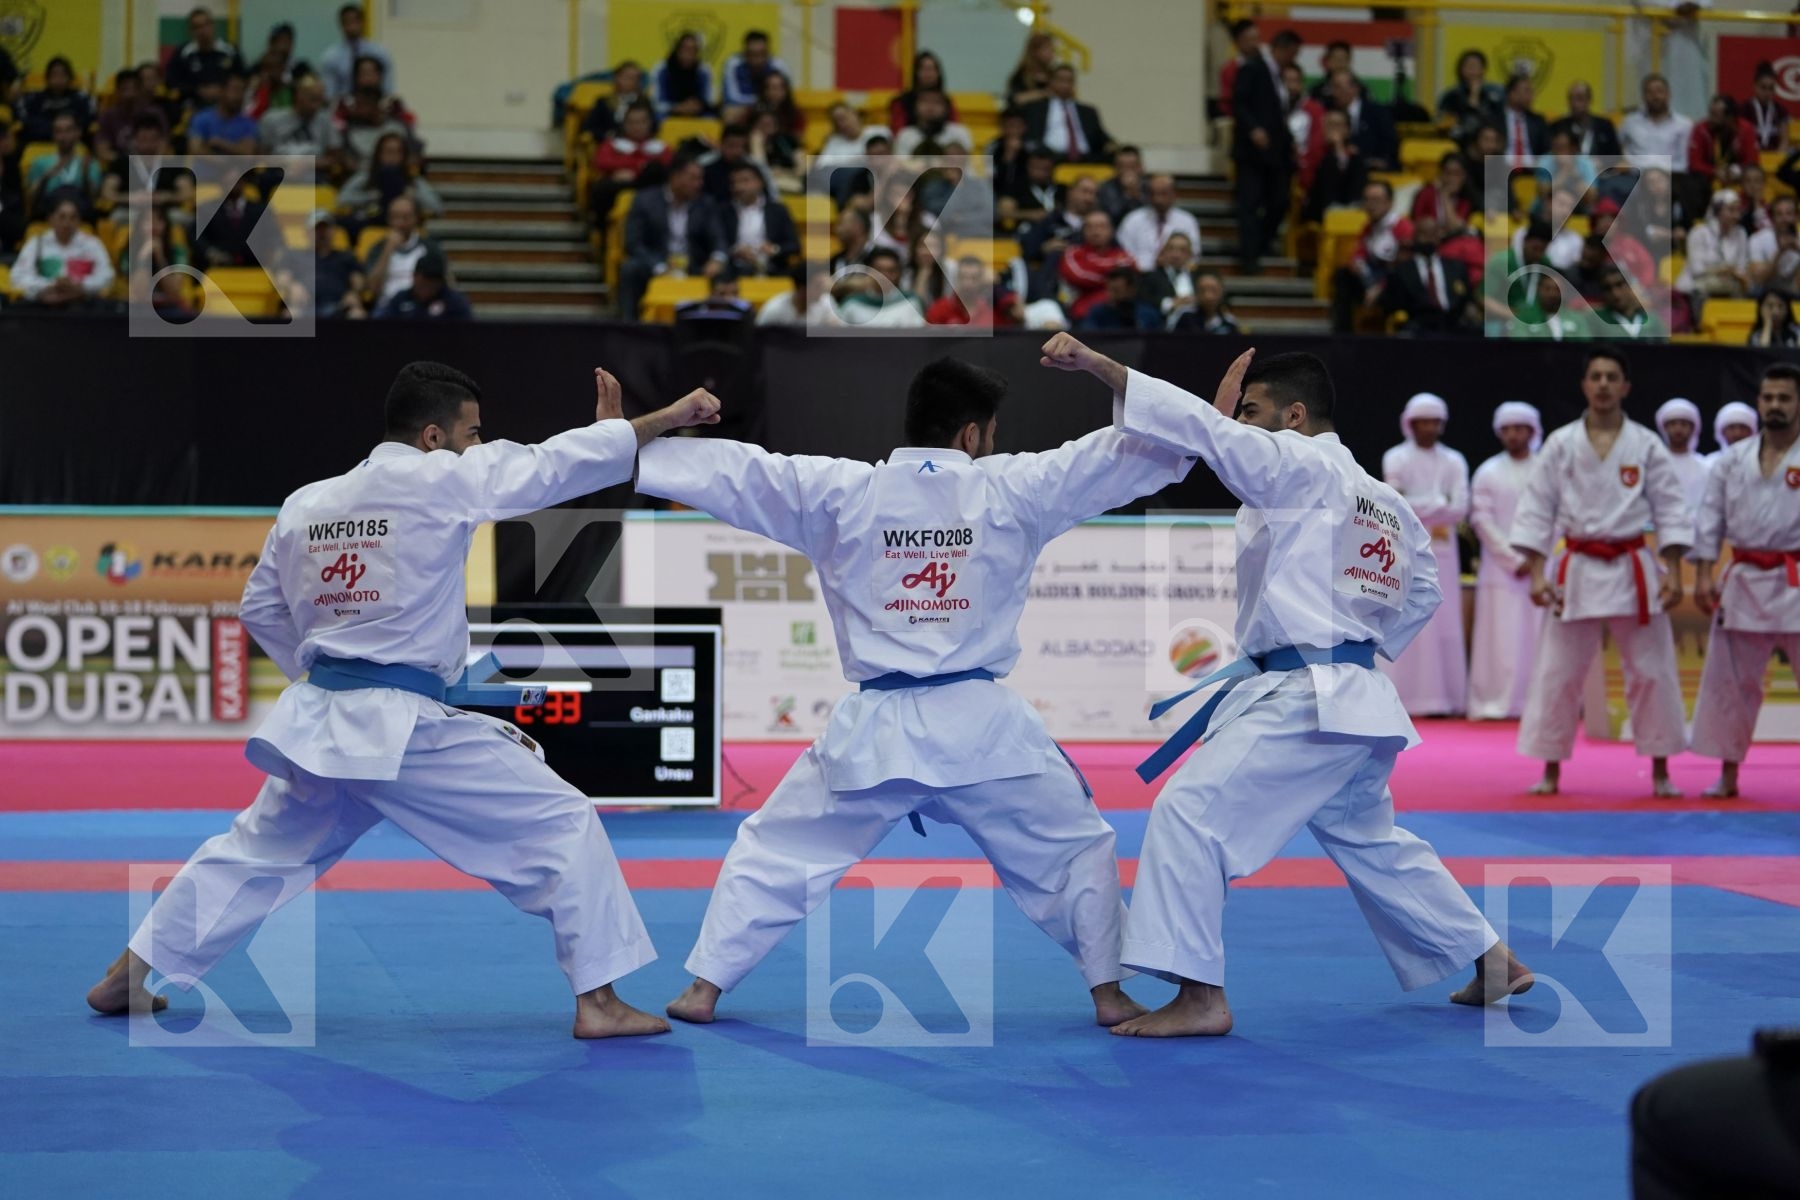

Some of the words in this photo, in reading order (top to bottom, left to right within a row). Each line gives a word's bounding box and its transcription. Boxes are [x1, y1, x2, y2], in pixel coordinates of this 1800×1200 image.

[309, 519, 389, 541] WKF0185
[883, 528, 973, 547] WKF0208
[308, 545, 321, 553] Eat
[342, 541, 359, 550] Live
[885, 550, 901, 559] Eat
[930, 550, 950, 559] Live
[152, 550, 261, 568] KARA
[1344, 566, 1400, 591] AJINOMOTO
[314, 590, 381, 607] AJINOMOTO
[884, 598, 970, 612] AJINOMOTO
[6, 616, 211, 672] OPEN
[219, 622, 242, 719] KARATE
[5, 672, 211, 723] DUBAI
[654, 765, 694, 782] Unsu
